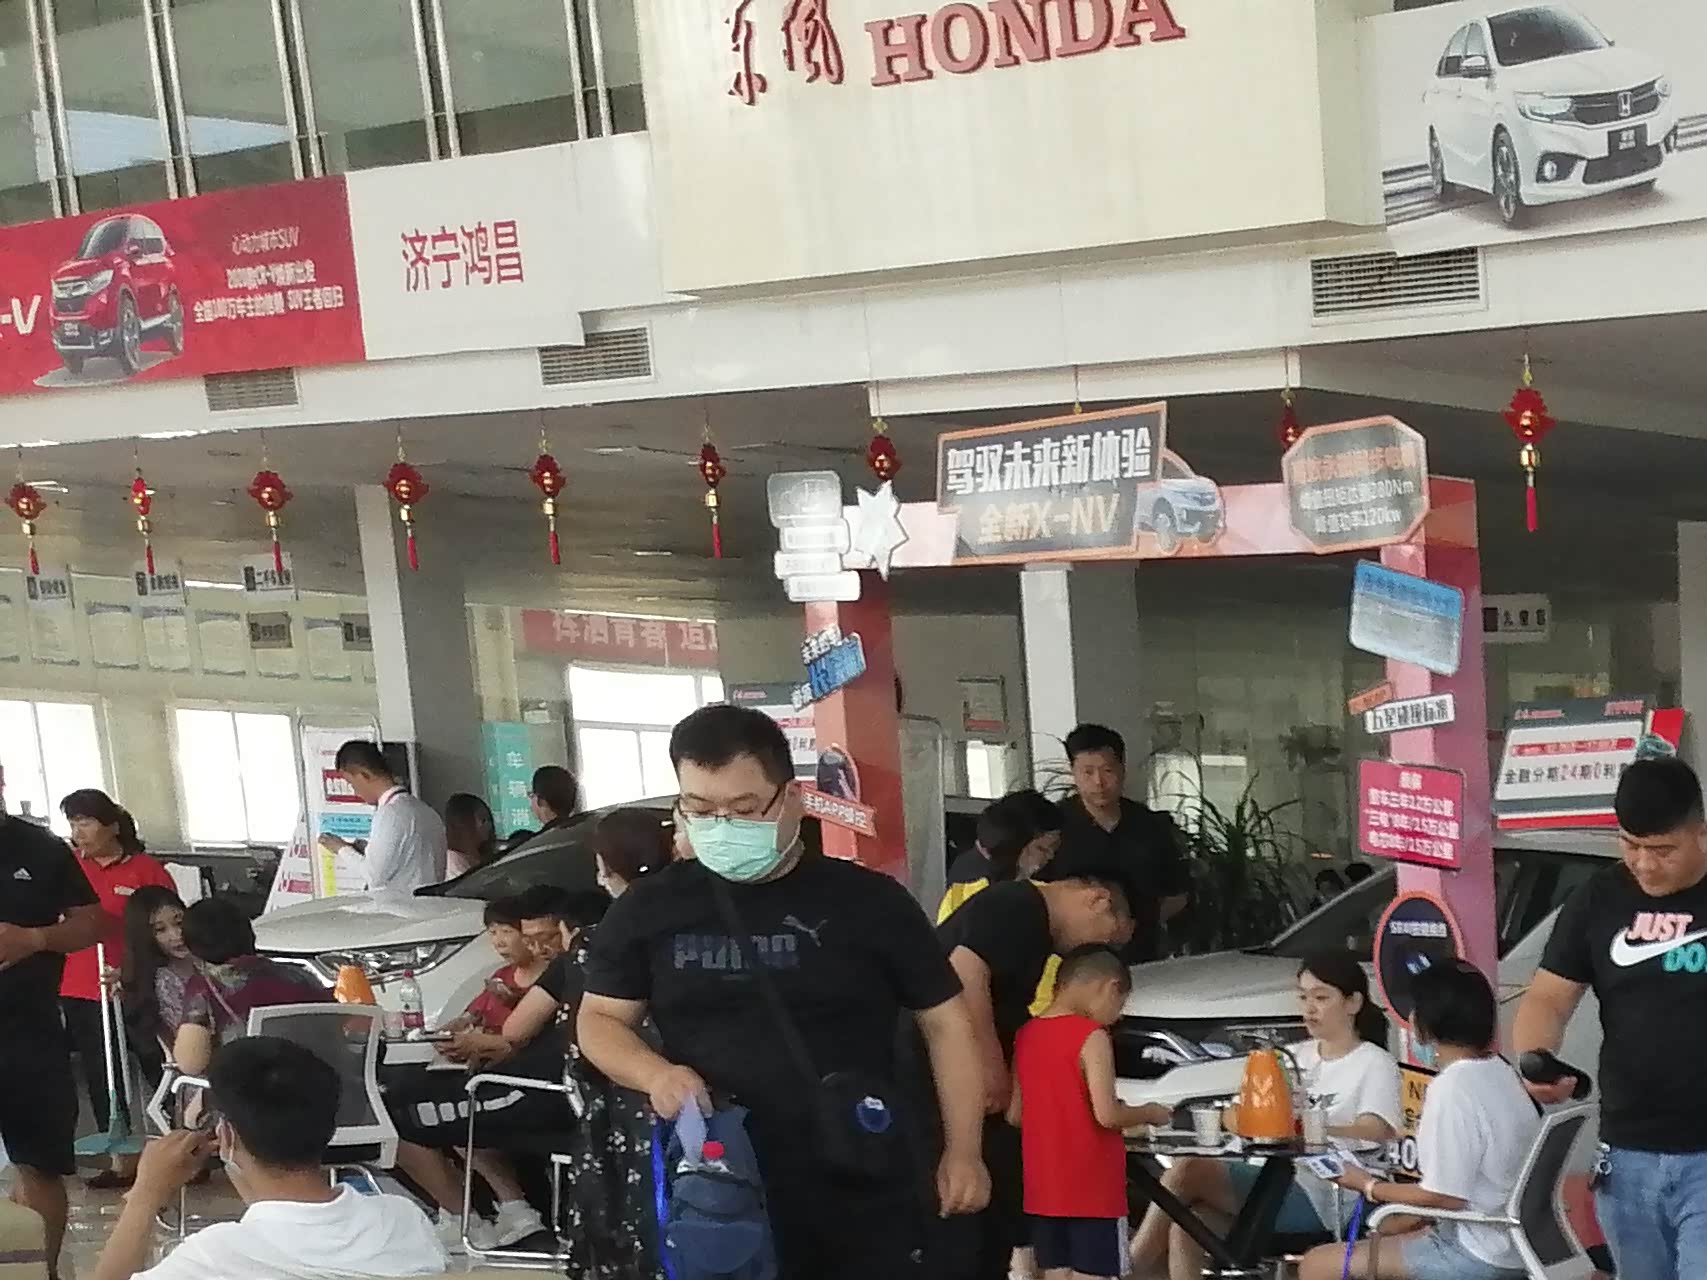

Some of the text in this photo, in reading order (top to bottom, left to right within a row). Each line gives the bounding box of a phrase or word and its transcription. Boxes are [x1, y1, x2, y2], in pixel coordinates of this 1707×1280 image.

[862, 0, 1187, 88] HONDA
[401, 220, 525, 291] 济宁鸿昌
[946, 427, 1152, 495] 驾驭未来新体验
[1503, 762, 1629, 785] 金融分期24期0利
[1626, 911, 1694, 942] JUST
